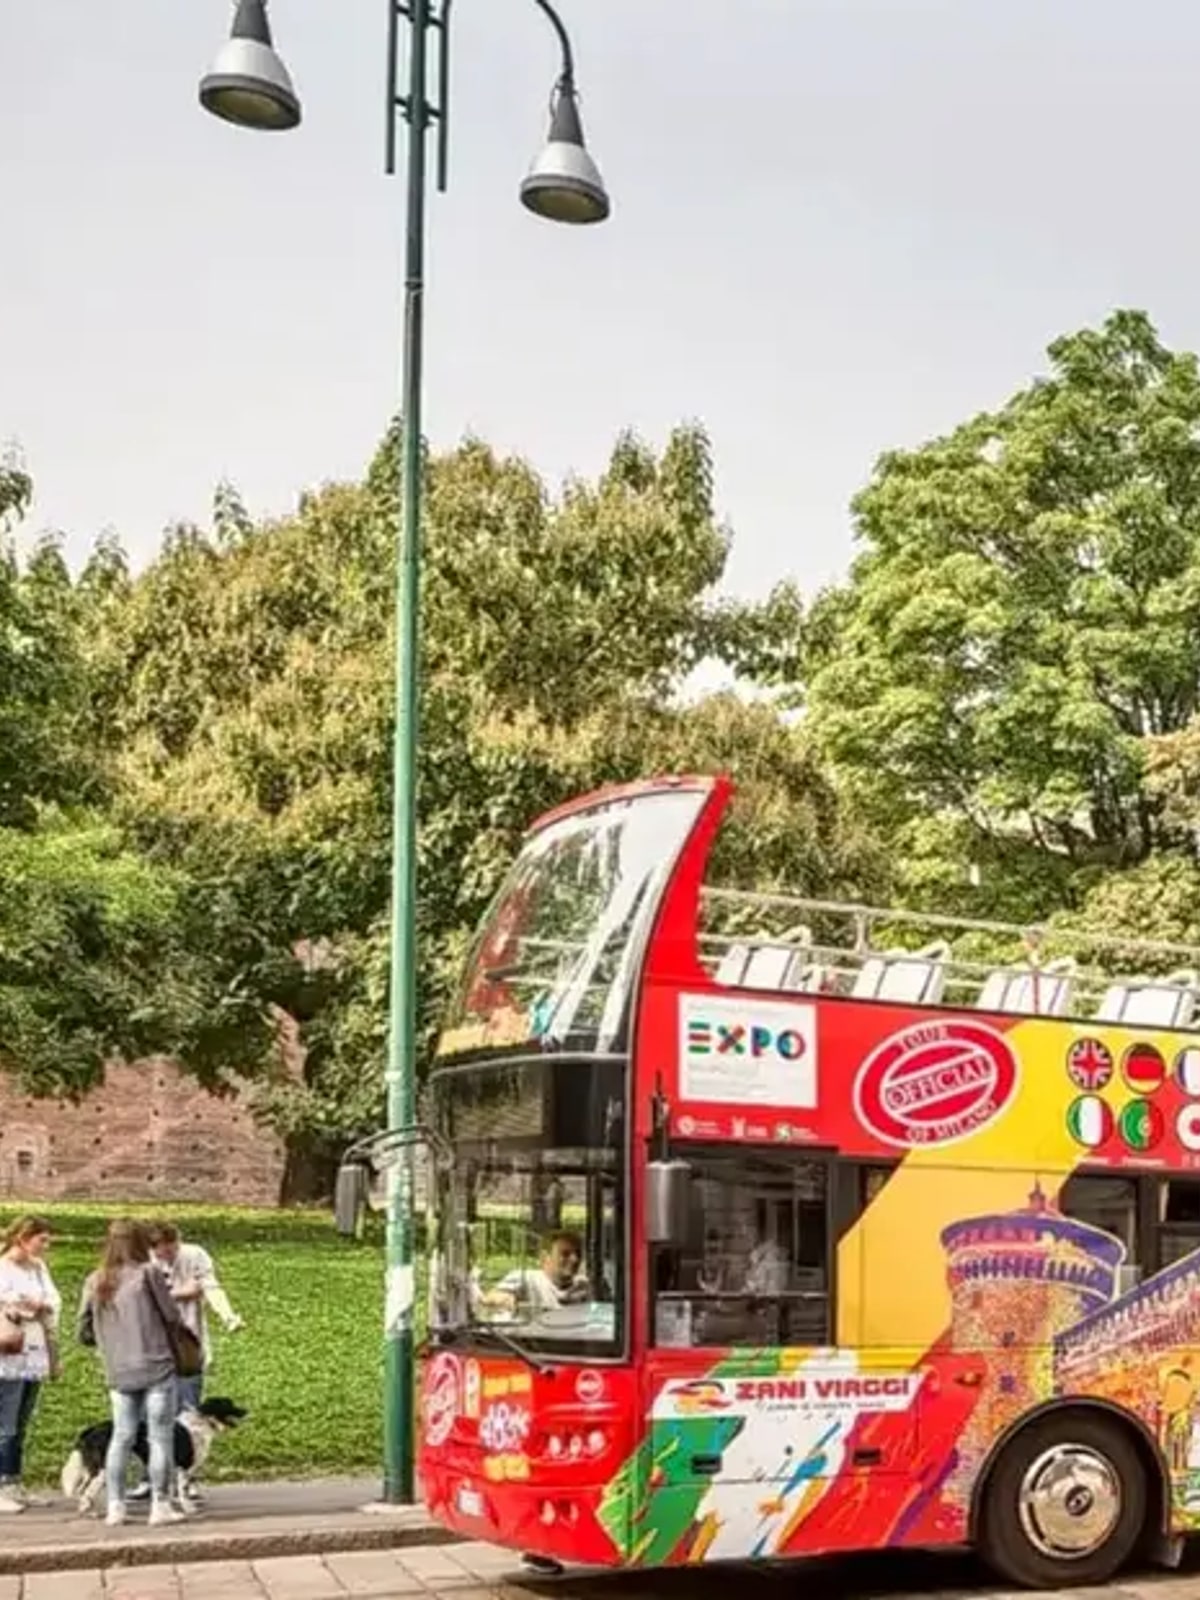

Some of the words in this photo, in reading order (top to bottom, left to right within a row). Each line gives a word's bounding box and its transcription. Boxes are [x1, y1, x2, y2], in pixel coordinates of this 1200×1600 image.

[688, 1021, 805, 1060] EXPO
[884, 1054, 992, 1110] OFFICIAL
[735, 1380, 806, 1401] ZANI
[814, 1378, 910, 1398] VIAGGI
